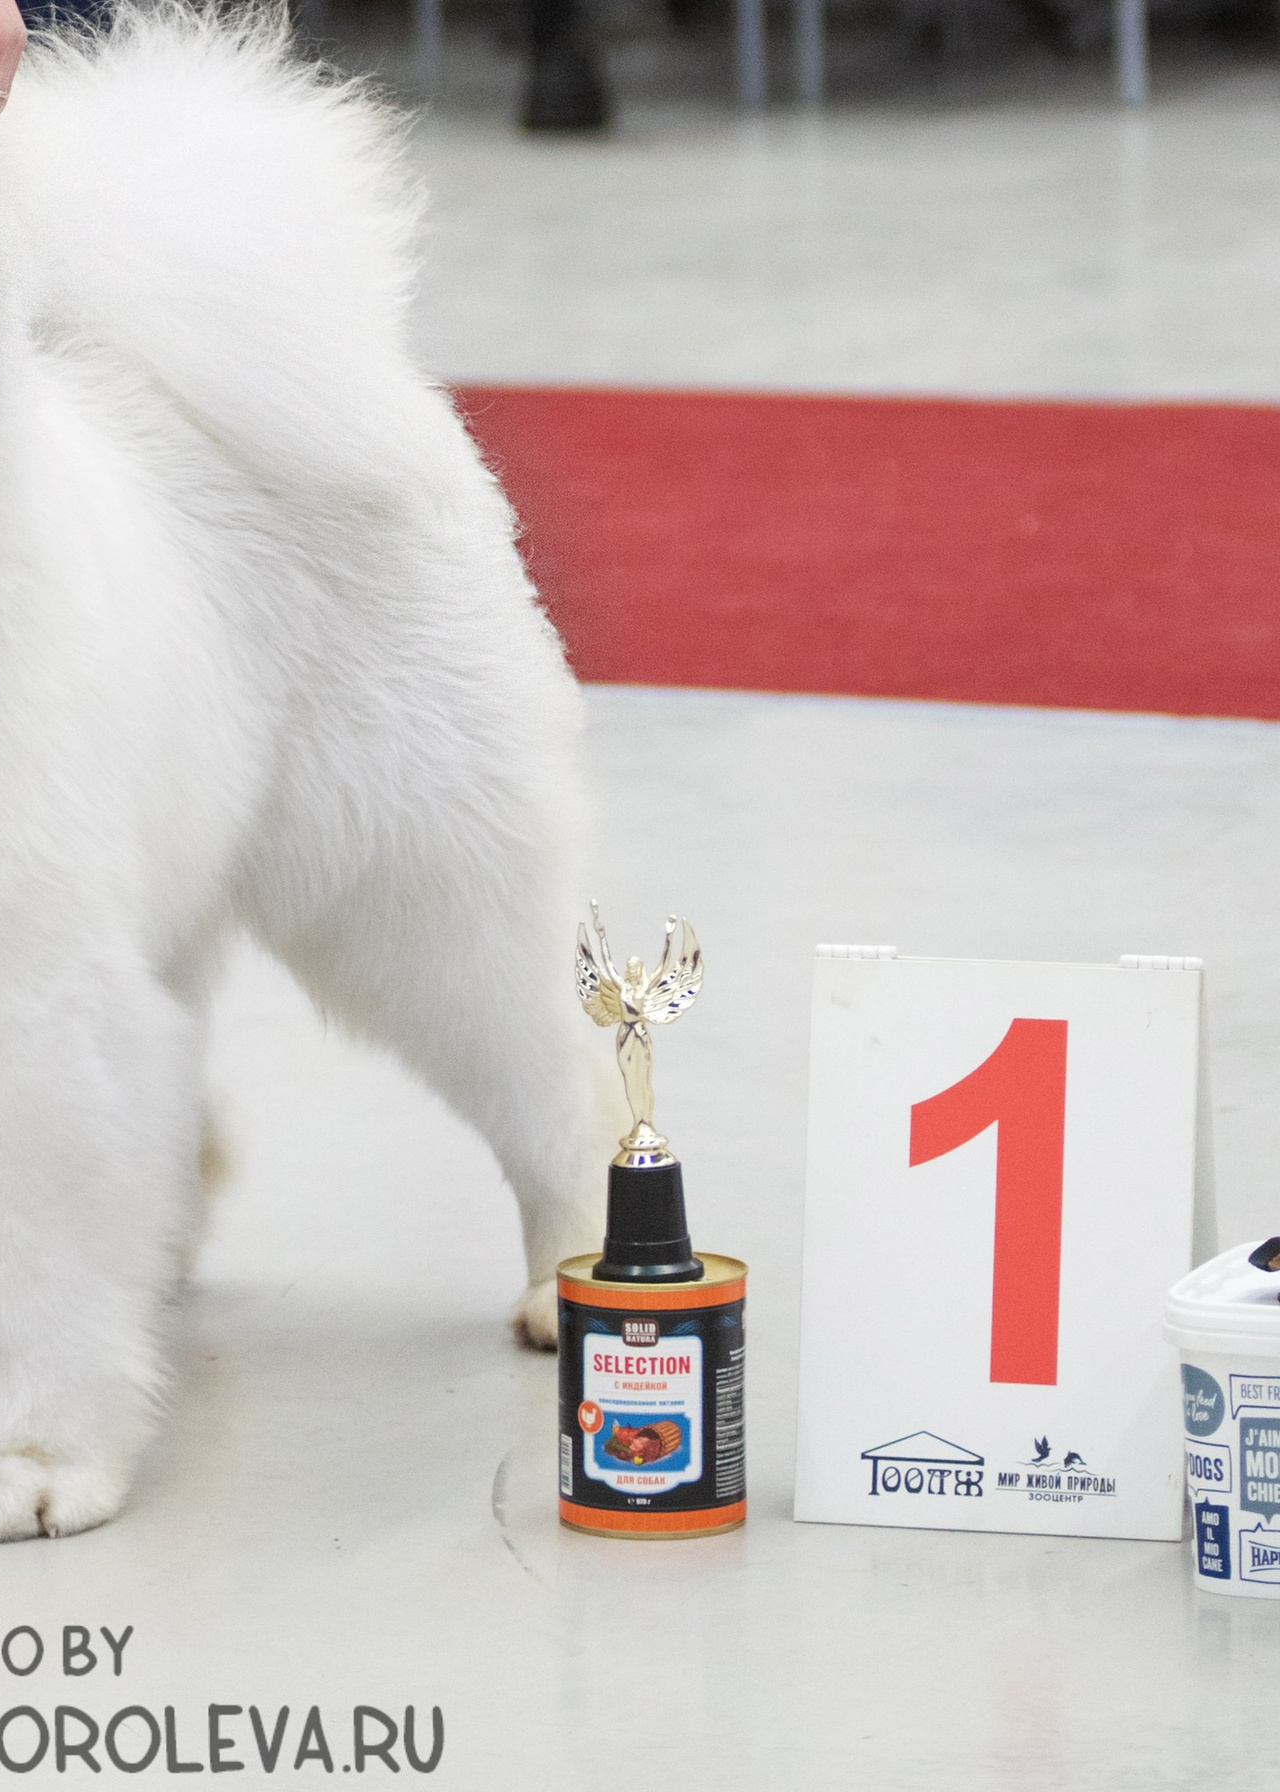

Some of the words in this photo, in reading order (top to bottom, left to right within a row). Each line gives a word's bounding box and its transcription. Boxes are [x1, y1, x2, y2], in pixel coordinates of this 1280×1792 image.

[909, 1018, 1068, 1386] 1
[625, 1322, 656, 1333] SOLID
[626, 1335, 656, 1343] NATURA
[593, 1353, 691, 1376] SELECTION
[622, 1380, 668, 1392] ИНДЕЙКОЙ
[1240, 1383, 1263, 1400] BEST
[1189, 1452, 1224, 1482] DOGS
[616, 1474, 635, 1485] ДЛЯ
[637, 1476, 666, 1485] СОБАК
[997, 1471, 1021, 1488] МИР
[1026, 1472, 1062, 1490] ЖИВОЙ
[1067, 1475, 1116, 1494] ПРИРОДЫ
[1028, 1492, 1084, 1504] ЗООЦЕНТР
[1201, 1510, 1220, 1527] AMO
[1202, 1556, 1224, 1572] CANE
